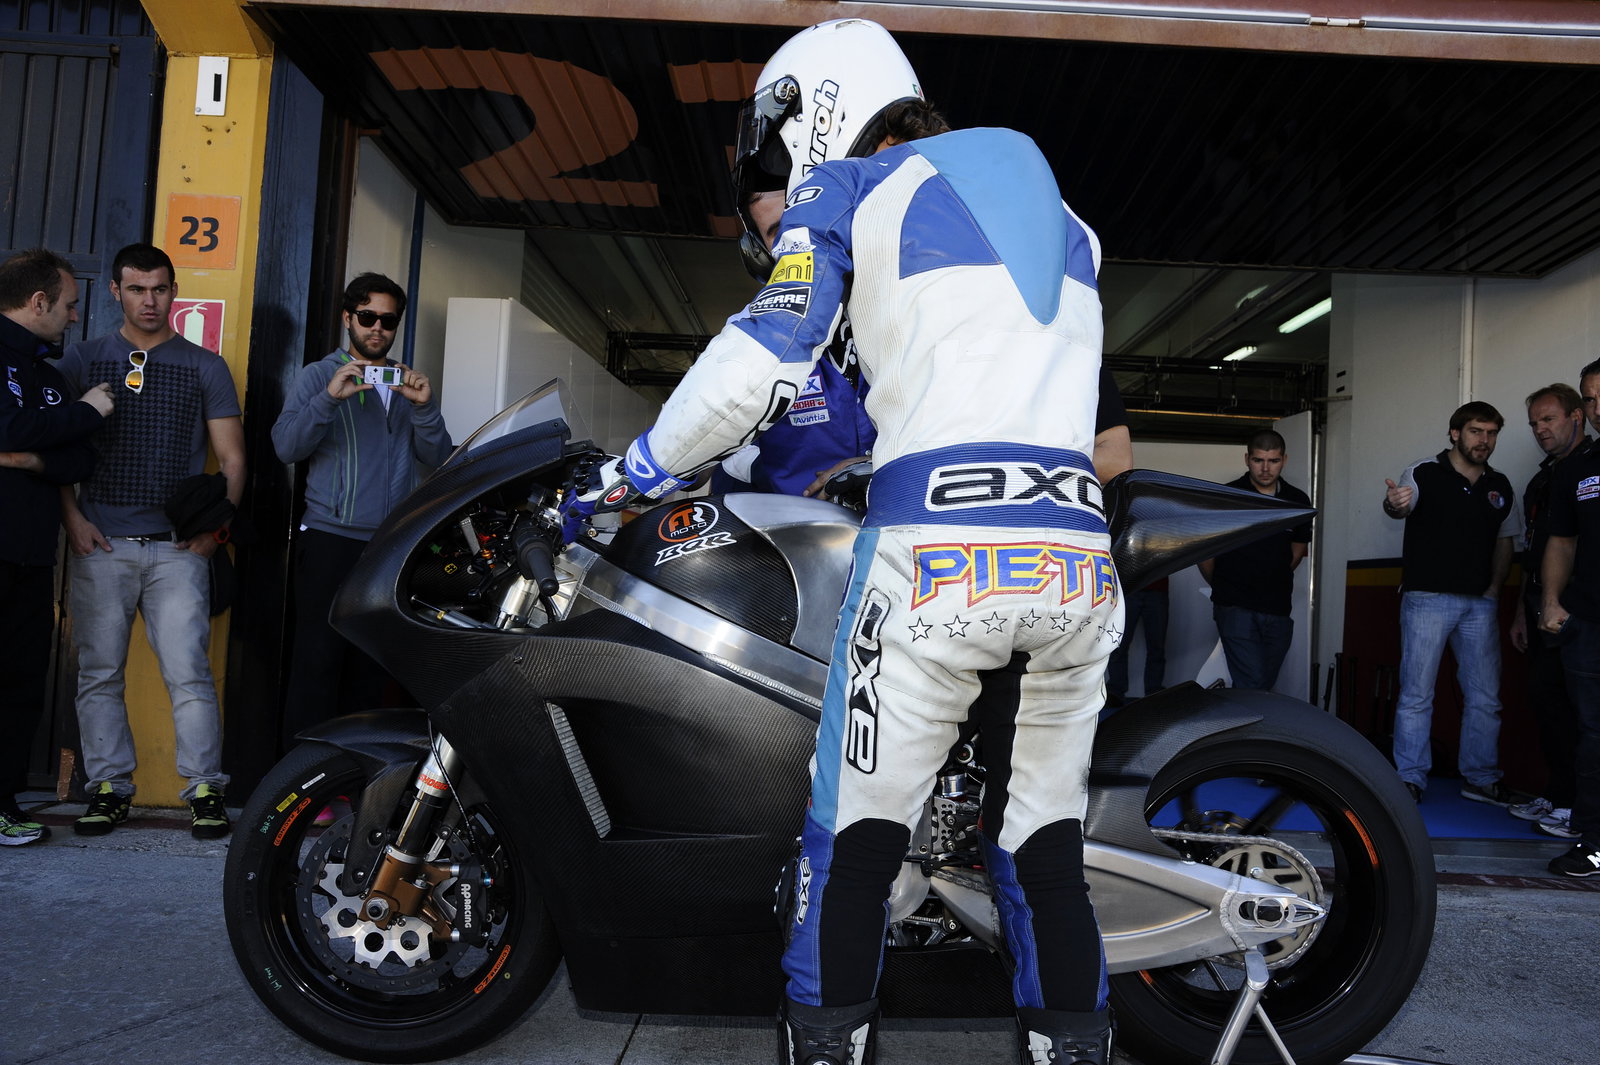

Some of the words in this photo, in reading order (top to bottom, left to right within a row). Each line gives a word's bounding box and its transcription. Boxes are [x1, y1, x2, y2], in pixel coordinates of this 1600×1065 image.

[179, 216, 220, 253] 23
[771, 255, 812, 283] eni
[794, 413, 826, 424] Avintia
[668, 507, 706, 532] FTR
[670, 522, 707, 538] MOTO
[463, 898, 472, 929] RACING
